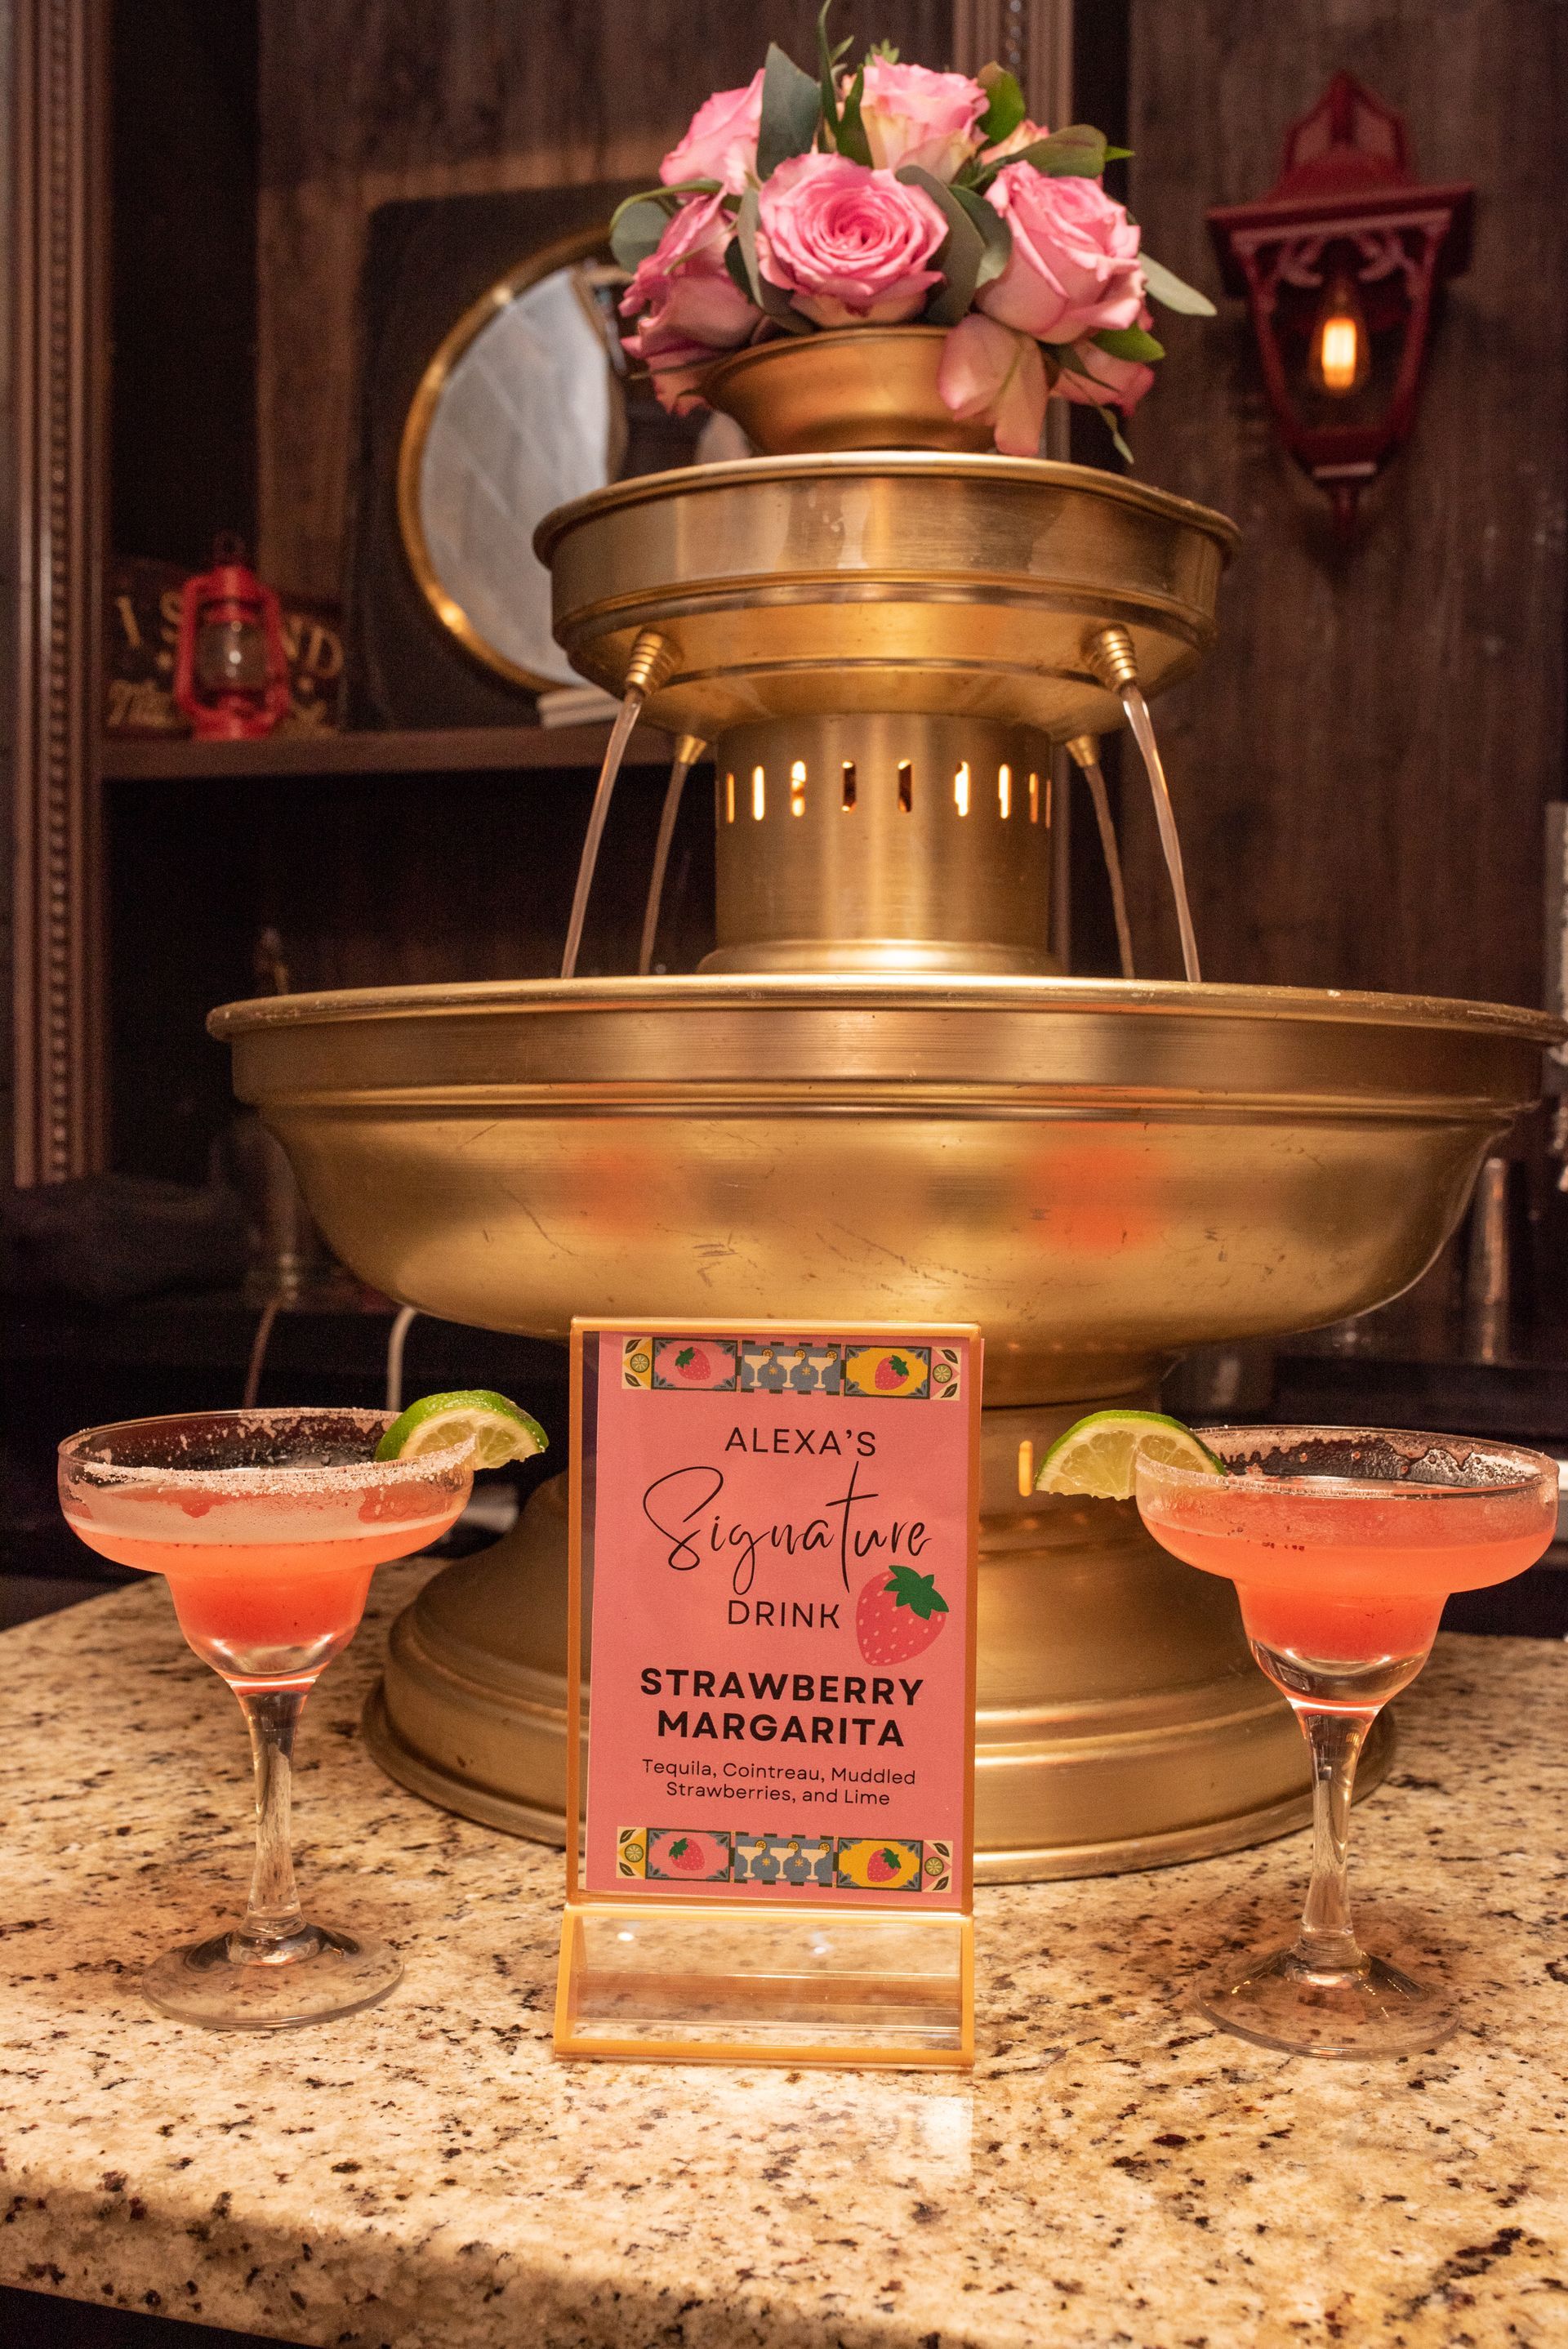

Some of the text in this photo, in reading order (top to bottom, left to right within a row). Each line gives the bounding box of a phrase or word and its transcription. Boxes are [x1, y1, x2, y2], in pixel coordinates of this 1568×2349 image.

[724, 1426, 877, 1457] ALEXA'S
[642, 1460, 933, 1596] Signature
[727, 1599, 840, 1629] DRINK
[639, 1667, 924, 1706] STRAWBERRY
[657, 1709, 906, 1747] MARGARITA
[642, 1758, 916, 1785] Tequila, Cointreau, Muddled
[666, 1781, 891, 1807] Strawberries, and Lime
